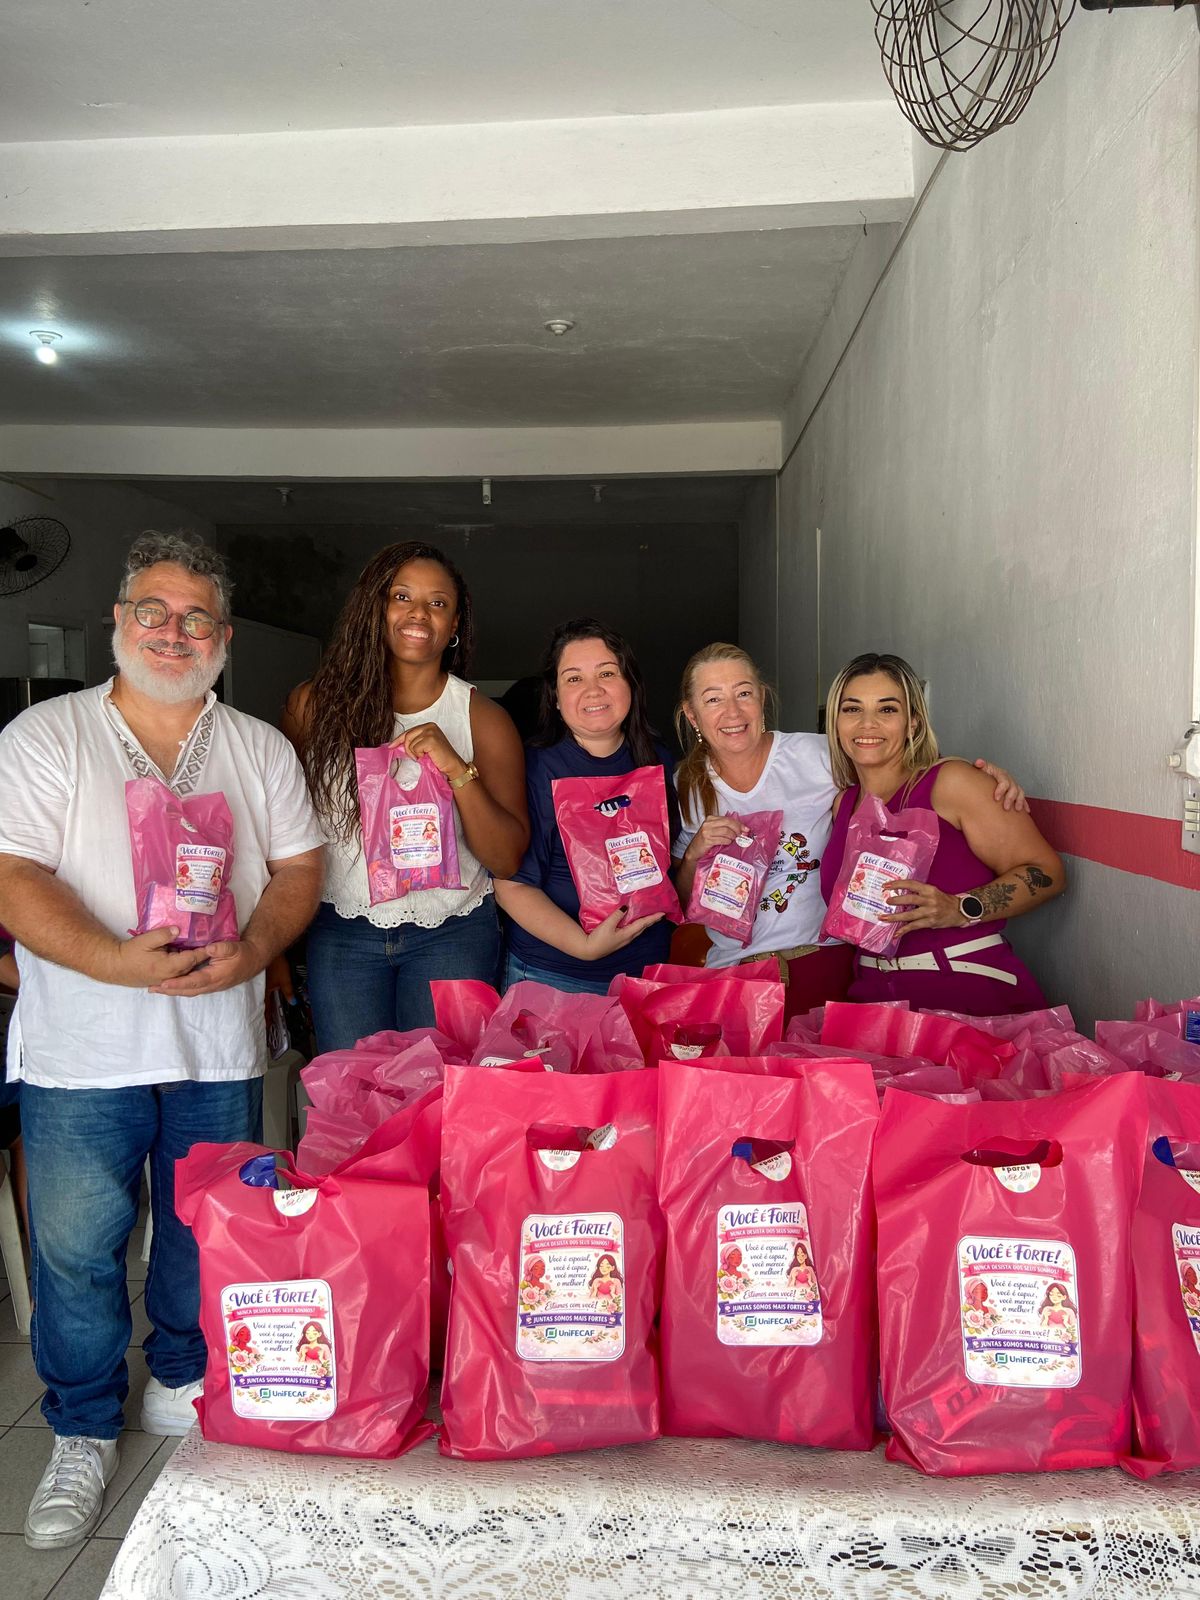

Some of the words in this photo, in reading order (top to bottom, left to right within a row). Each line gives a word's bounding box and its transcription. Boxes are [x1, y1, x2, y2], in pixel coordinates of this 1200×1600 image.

[725, 1209, 759, 1227] VOCÊ
[761, 1209, 766, 1222] É
[768, 1208, 800, 1224] FORTE!
[530, 1221, 563, 1239] VOCÊ
[564, 1221, 569, 1233] É
[571, 1220, 612, 1236] FORTE!
[549, 1255, 561, 1263] Você
[967, 1244, 1004, 1260] VOCÊ
[1006, 1246, 1012, 1257] É
[1013, 1244, 1062, 1264] FORTE!
[229, 1289, 263, 1307] VOCÊ
[266, 1291, 271, 1302] É
[272, 1288, 317, 1304] FORTE!
[743, 1290, 766, 1299] Estamos
[545, 1301, 568, 1311] Estamos
[1008, 1305, 1034, 1313] melhor!
[992, 1326, 1017, 1336] Estamos
[1010, 1356, 1049, 1364] UniFECAF
